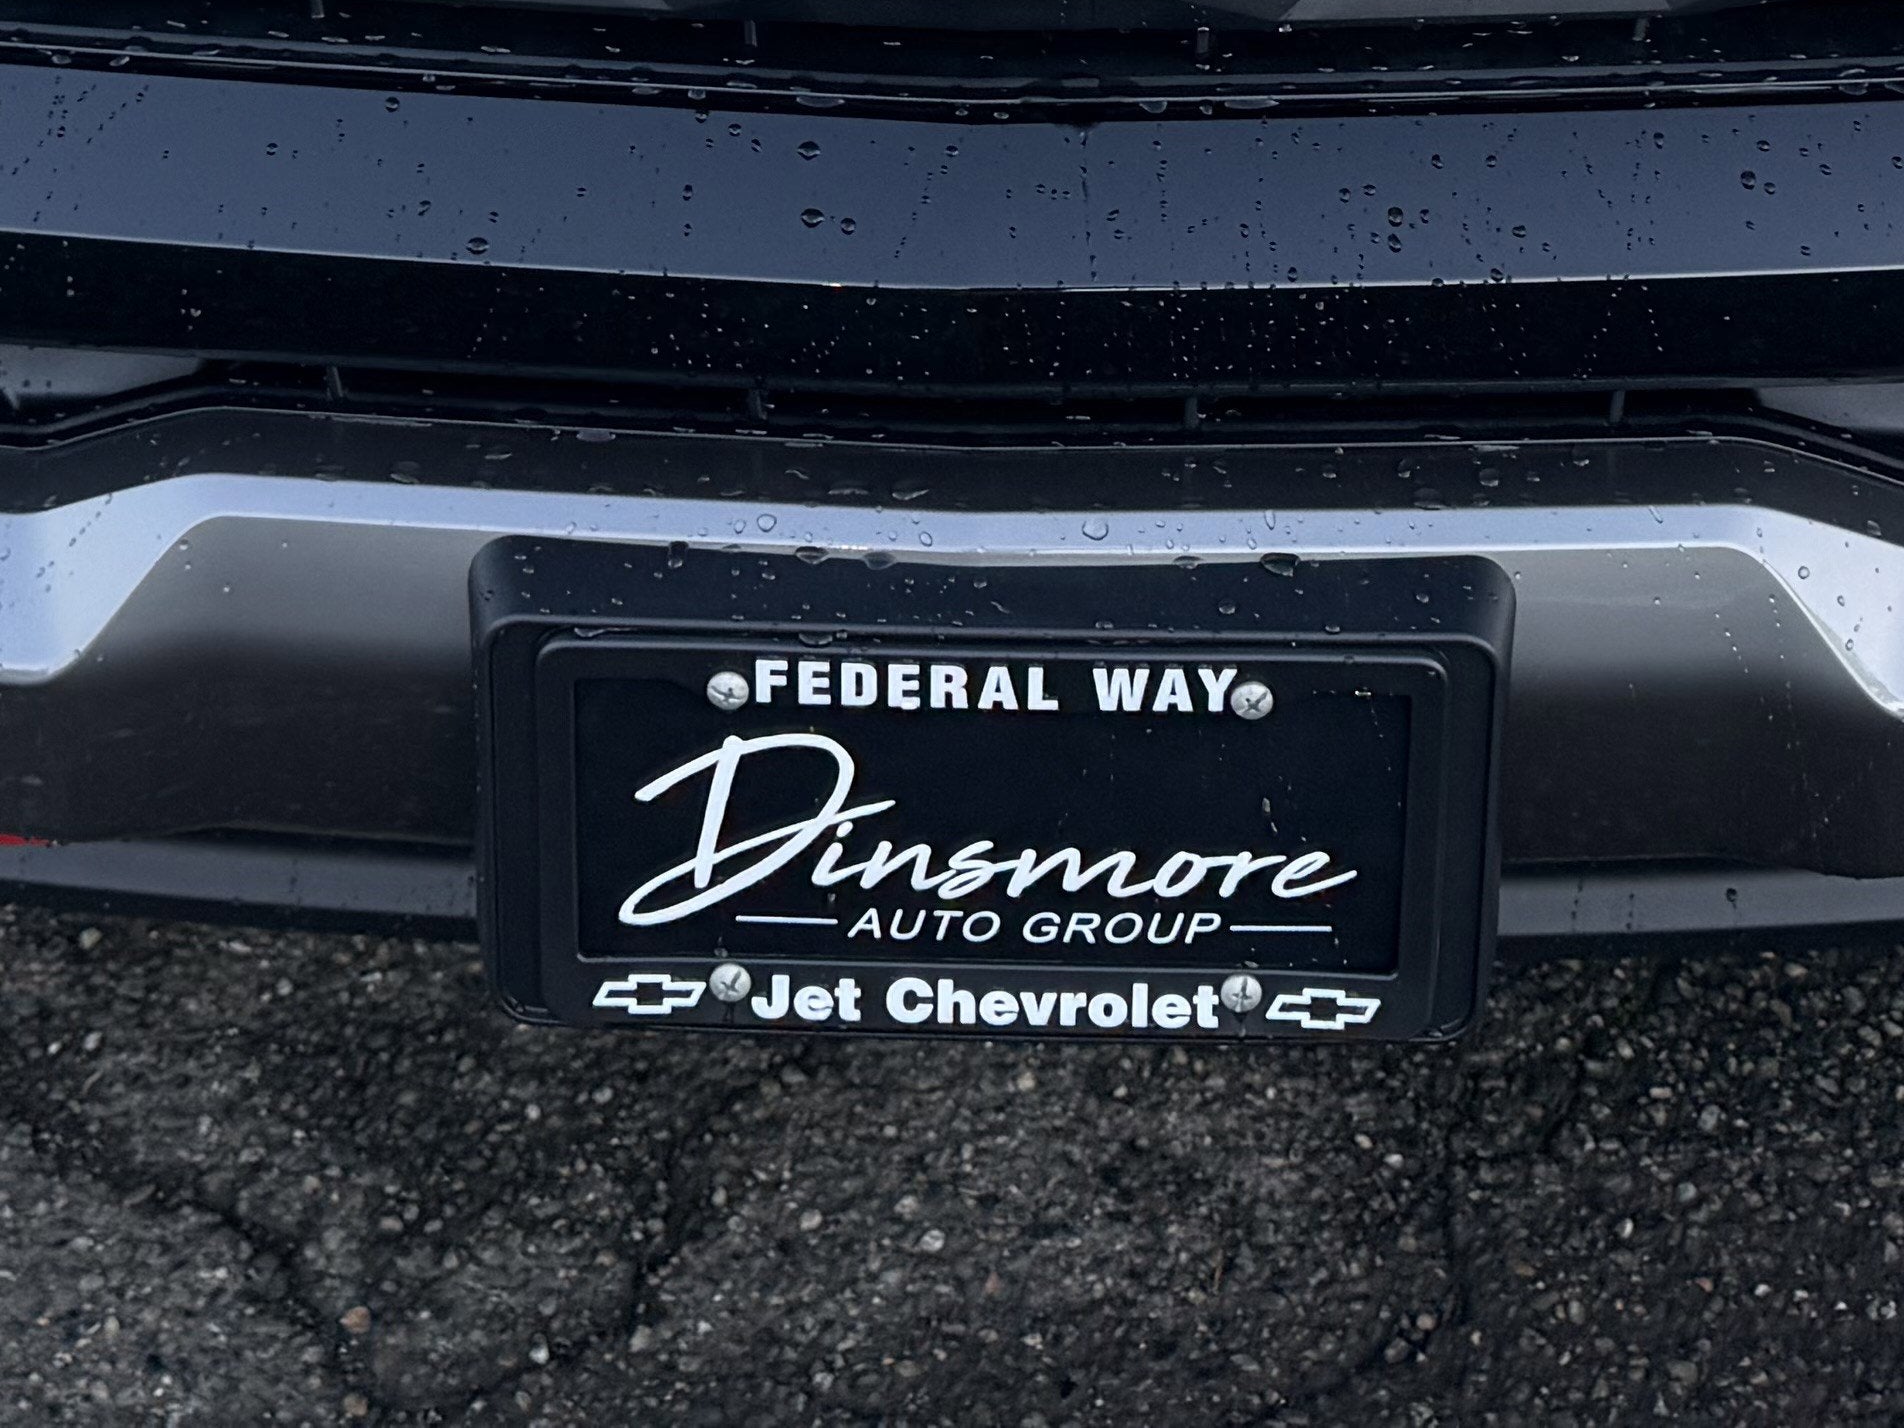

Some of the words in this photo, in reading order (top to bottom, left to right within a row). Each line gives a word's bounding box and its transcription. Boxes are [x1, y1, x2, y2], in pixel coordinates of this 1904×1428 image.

[755, 658, 1059, 711] FEDERAL
[1092, 667, 1238, 713] WAY
[619, 733, 1358, 926] Dinsmore
[847, 907, 1001, 943] AUTO
[1022, 911, 1222, 945] GROUP
[750, 973, 862, 1022] Jet
[885, 976, 1220, 1029] Chevrolet
